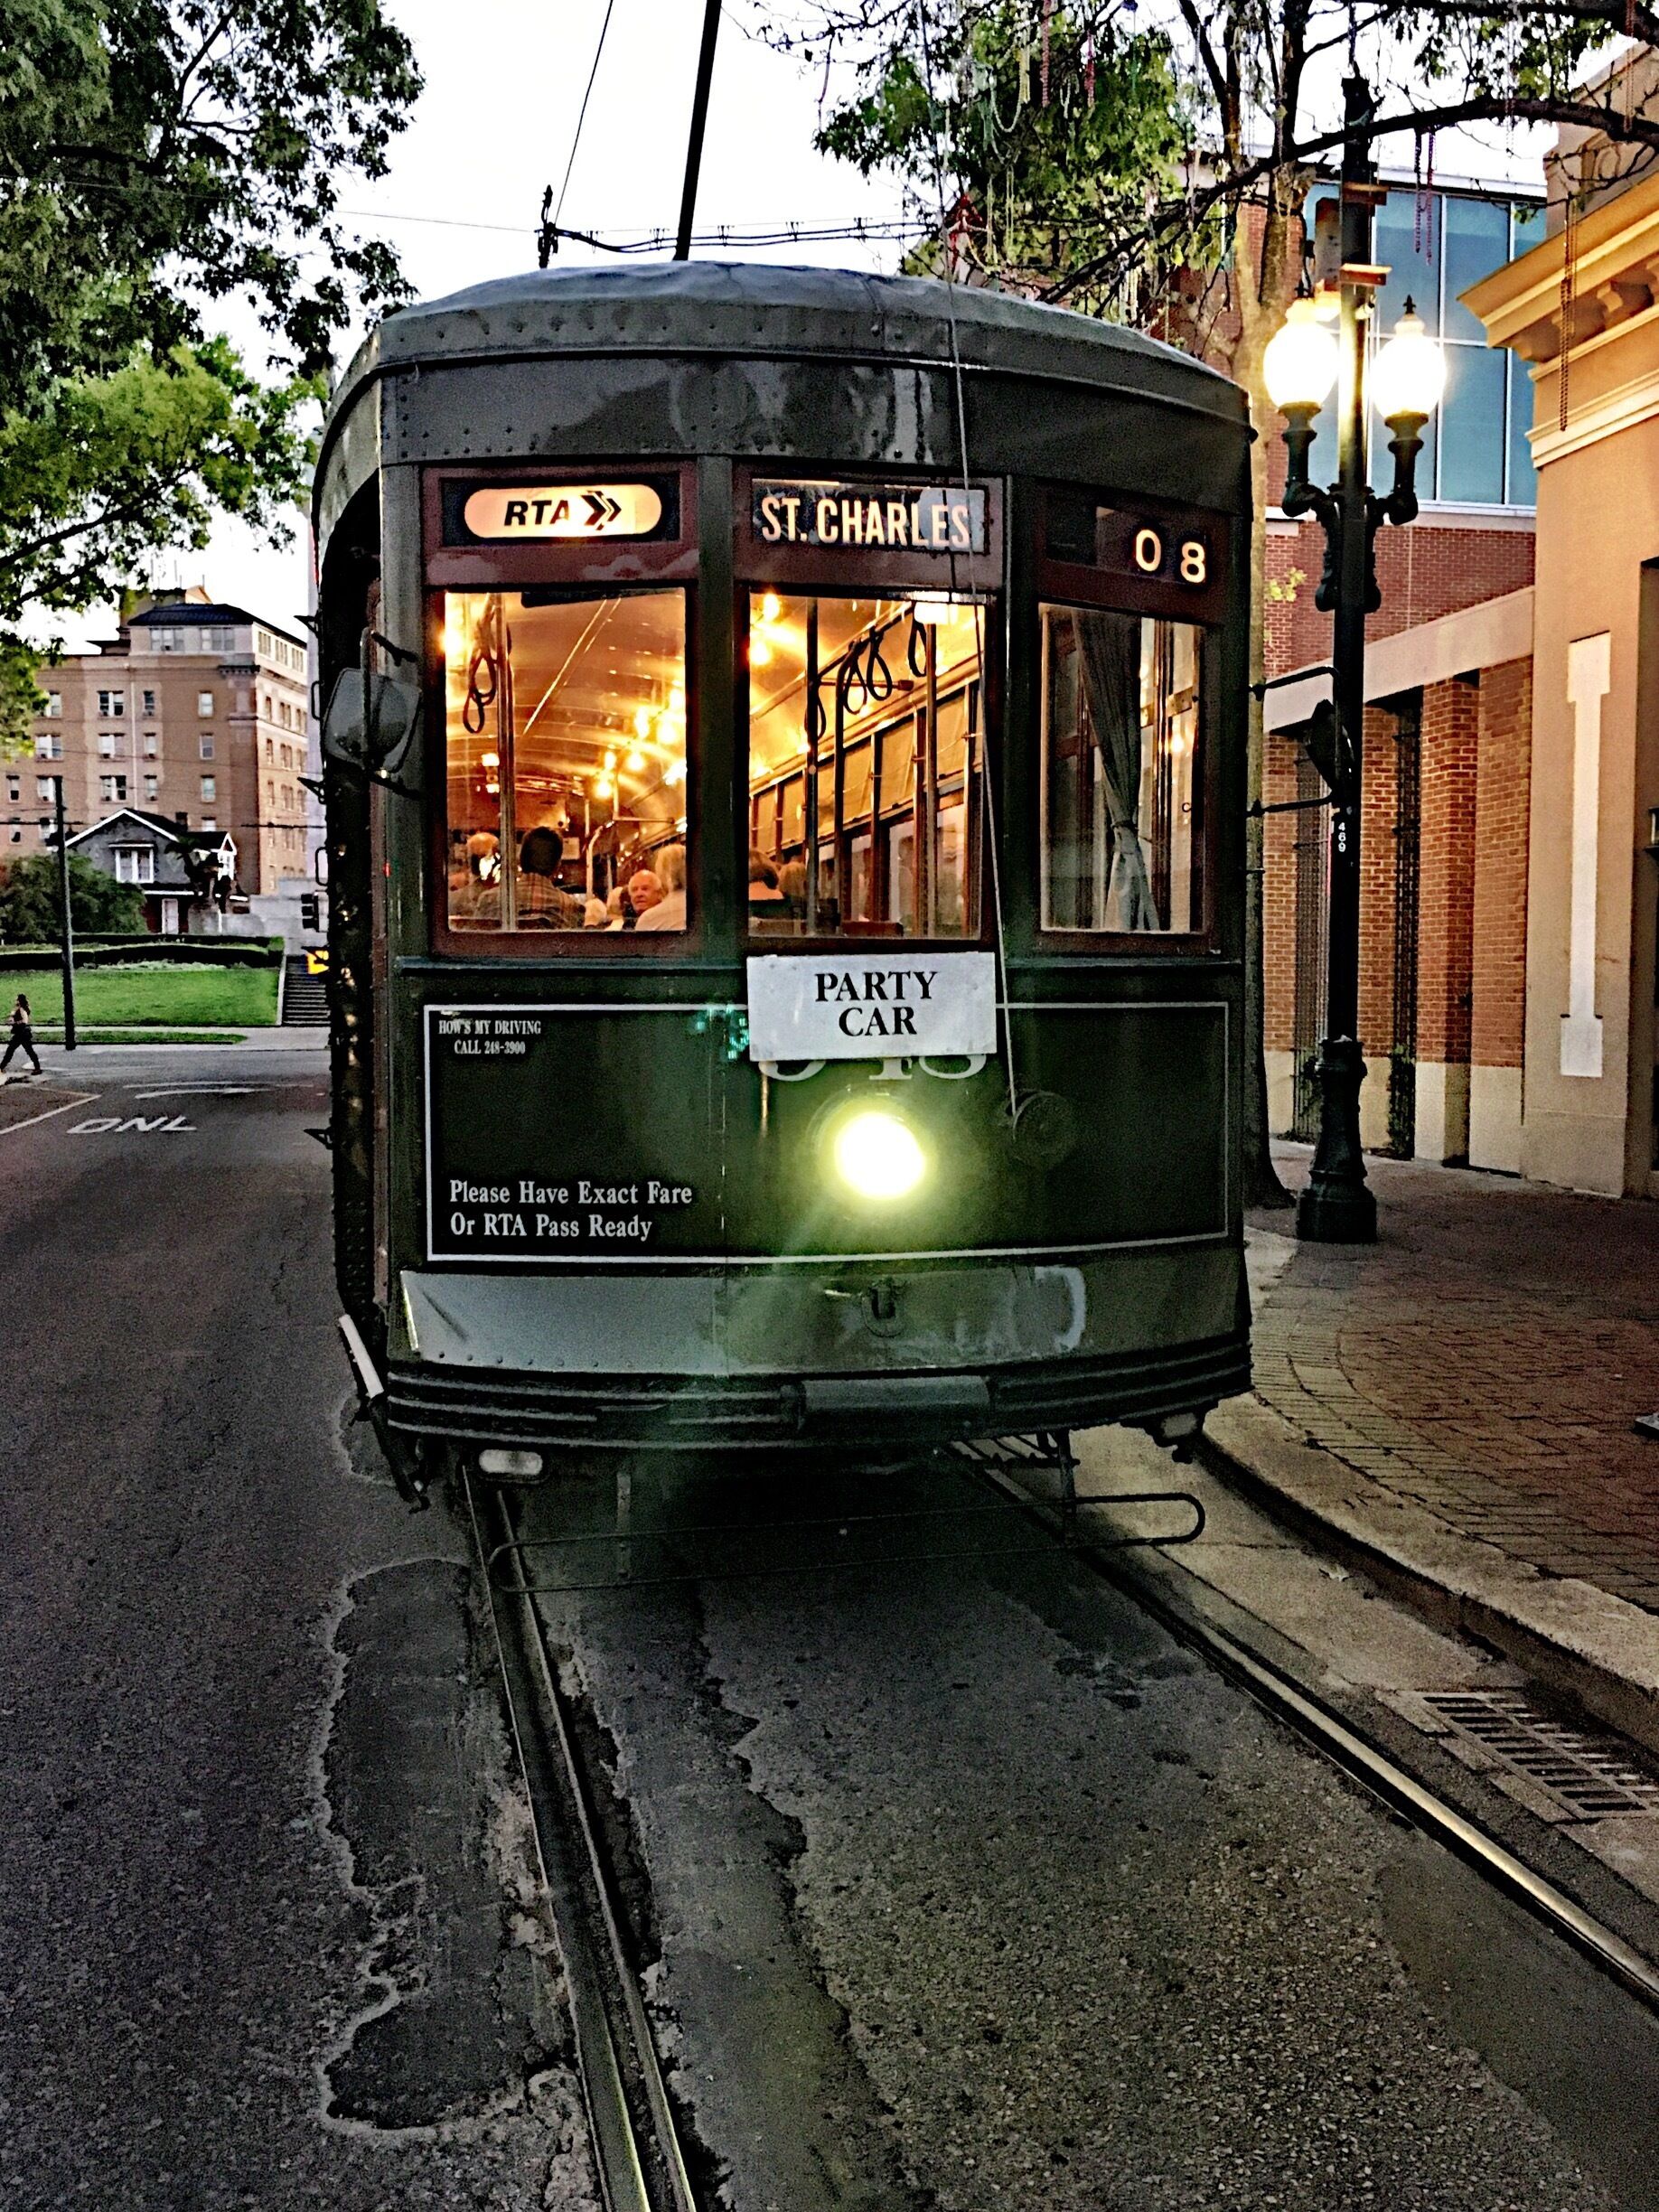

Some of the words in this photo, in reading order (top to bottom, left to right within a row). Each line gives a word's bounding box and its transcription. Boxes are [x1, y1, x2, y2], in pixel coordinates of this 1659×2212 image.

[504, 500, 569, 526] RTA
[762, 496, 808, 542] ST.
[817, 499, 970, 548] CHARLES
[1338, 822, 1346, 852] 469
[815, 971, 937, 1002] PARTY
[438, 1019, 472, 1035] HOW'S
[474, 1019, 491, 1035] MY
[494, 1020, 541, 1035] DRIVING
[839, 1007, 917, 1036] CAR
[454, 1040, 482, 1054] CALL
[450, 1179, 511, 1203] Please
[519, 1181, 568, 1204] Have
[578, 1181, 638, 1204] Exact
[647, 1181, 692, 1204] Fare
[451, 1212, 475, 1235] Or
[483, 1214, 527, 1236] RTA
[536, 1214, 580, 1237] Pass
[589, 1214, 652, 1242] Ready
